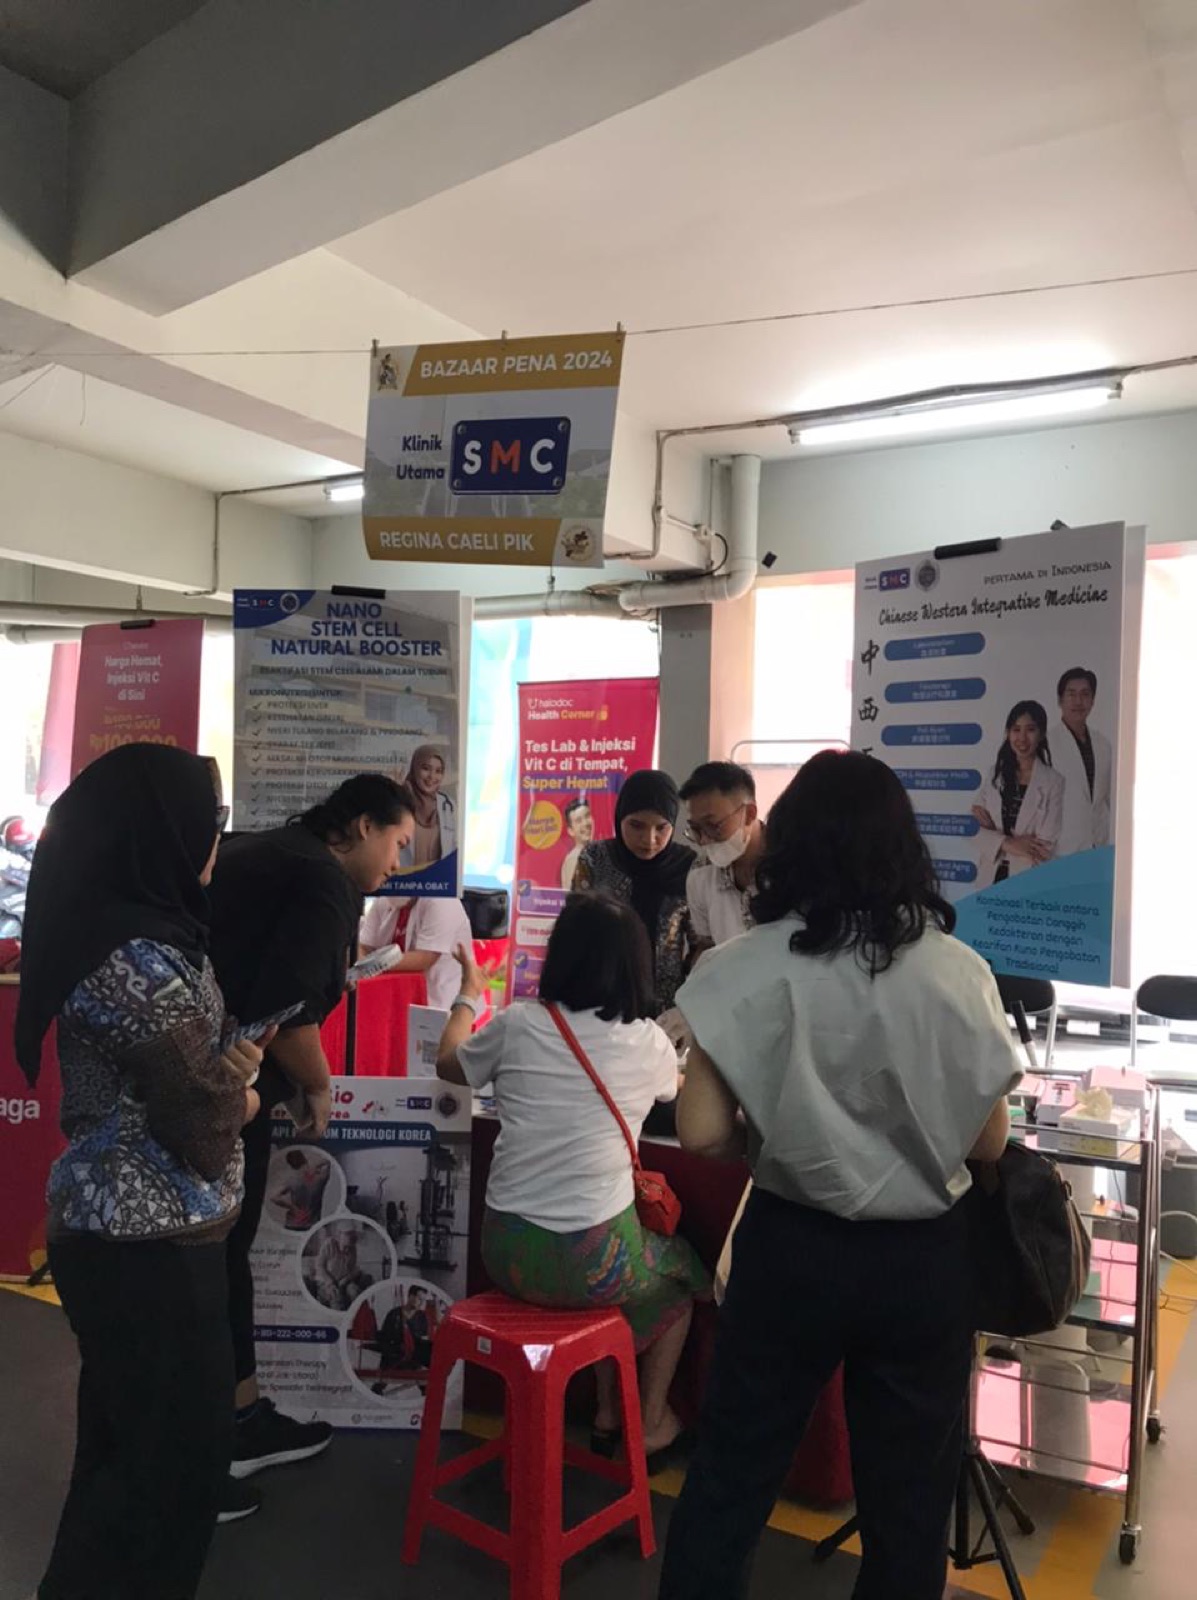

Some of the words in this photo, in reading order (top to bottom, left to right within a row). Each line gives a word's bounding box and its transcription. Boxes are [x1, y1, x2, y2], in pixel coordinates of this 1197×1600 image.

[420, 357, 497, 379] BAZAAR
[502, 354, 557, 374] PENA
[562, 350, 612, 371] 2024
[402, 434, 442, 452] Klinik
[461, 438, 556, 475] SMC
[396, 464, 445, 480] Utama
[379, 531, 444, 549] REGINA
[447, 532, 499, 551] CAELI
[503, 533, 535, 551] PIK
[983, 570, 1035, 585] PERTAMA
[1051, 560, 1112, 577] INDONESIA
[326, 603, 382, 619] NANO
[879, 608, 918, 626] Chinese
[921, 602, 968, 621] Western
[971, 592, 1041, 619] Integrative
[1045, 584, 1108, 608] Medicine
[311, 621, 357, 638] STEM
[362, 621, 403, 638] CELL
[271, 638, 355, 656] NATURAL
[359, 640, 442, 656] BOOSTER
[151, 671, 160, 684] C
[527, 710, 560, 721] Health
[560, 709, 595, 720] Corner
[525, 740, 549, 753] Tes
[551, 739, 577, 752] Lab
[579, 739, 590, 752] &
[591, 736, 637, 755] Injeksi
[524, 757, 543, 771] Vit
[545, 758, 557, 771] C
[559, 756, 573, 771] di
[576, 756, 628, 773] Tempat,
[522, 775, 563, 791] Super
[565, 775, 608, 790] Hemat
[394, 881, 423, 890] TANPA
[424, 881, 449, 891] OBAT
[341, 1128, 396, 1141] TEKNOLOGI
[398, 1129, 431, 1142] KOREA
